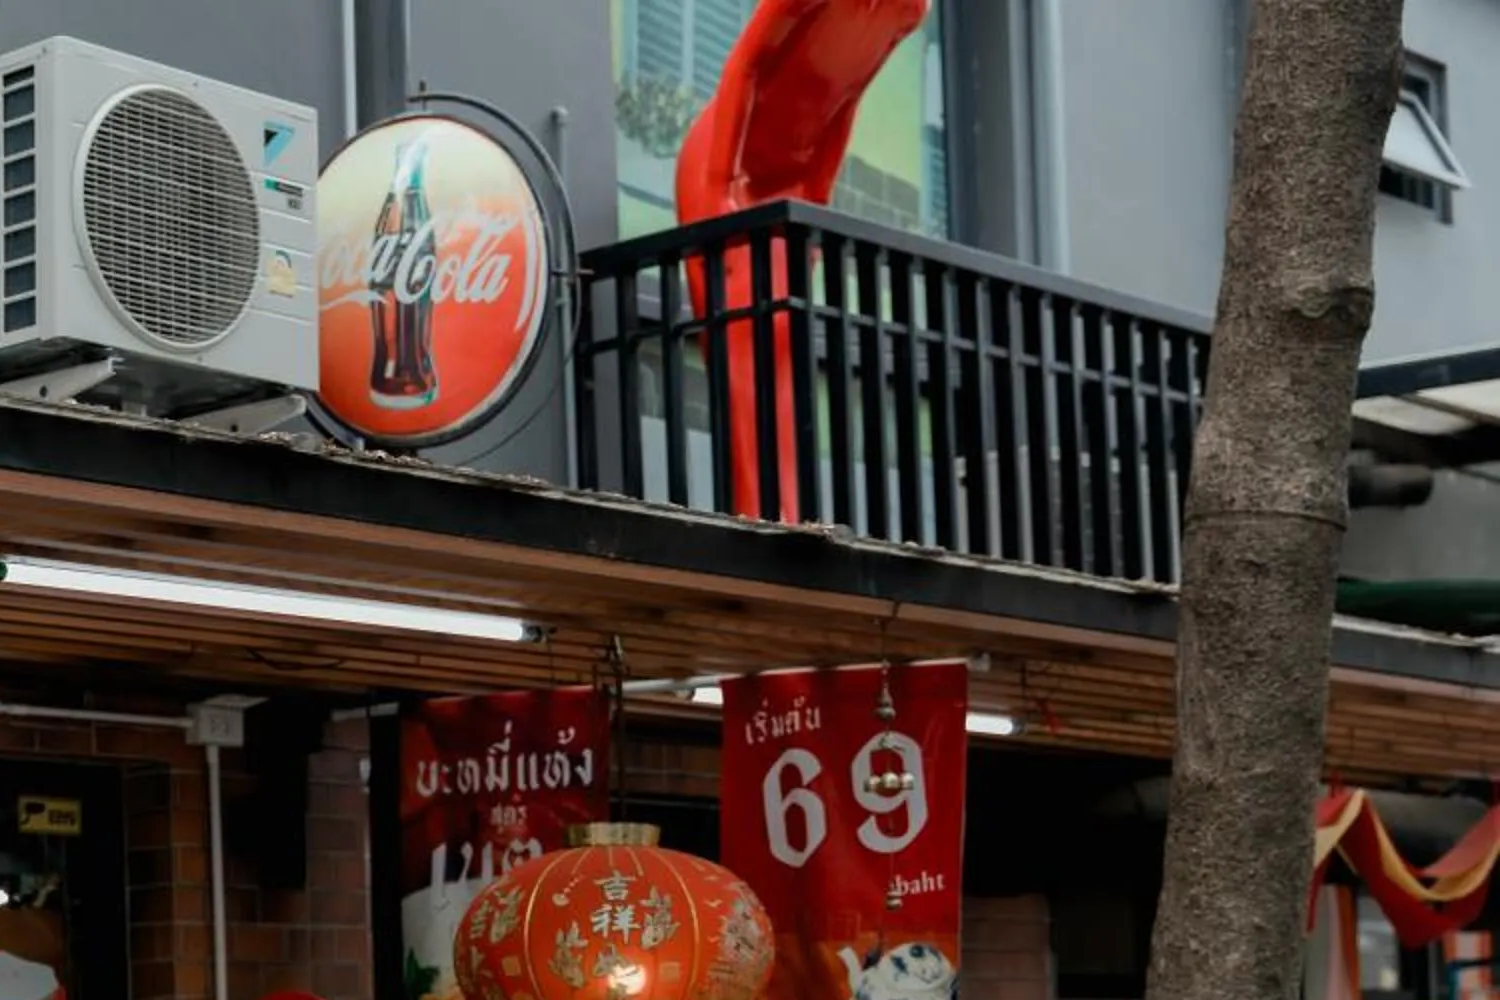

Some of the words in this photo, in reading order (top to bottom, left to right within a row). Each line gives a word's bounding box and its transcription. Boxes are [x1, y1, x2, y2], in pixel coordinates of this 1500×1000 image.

[415, 721, 594, 798] บะหมี่แห้ง
[762, 730, 929, 868] 69
